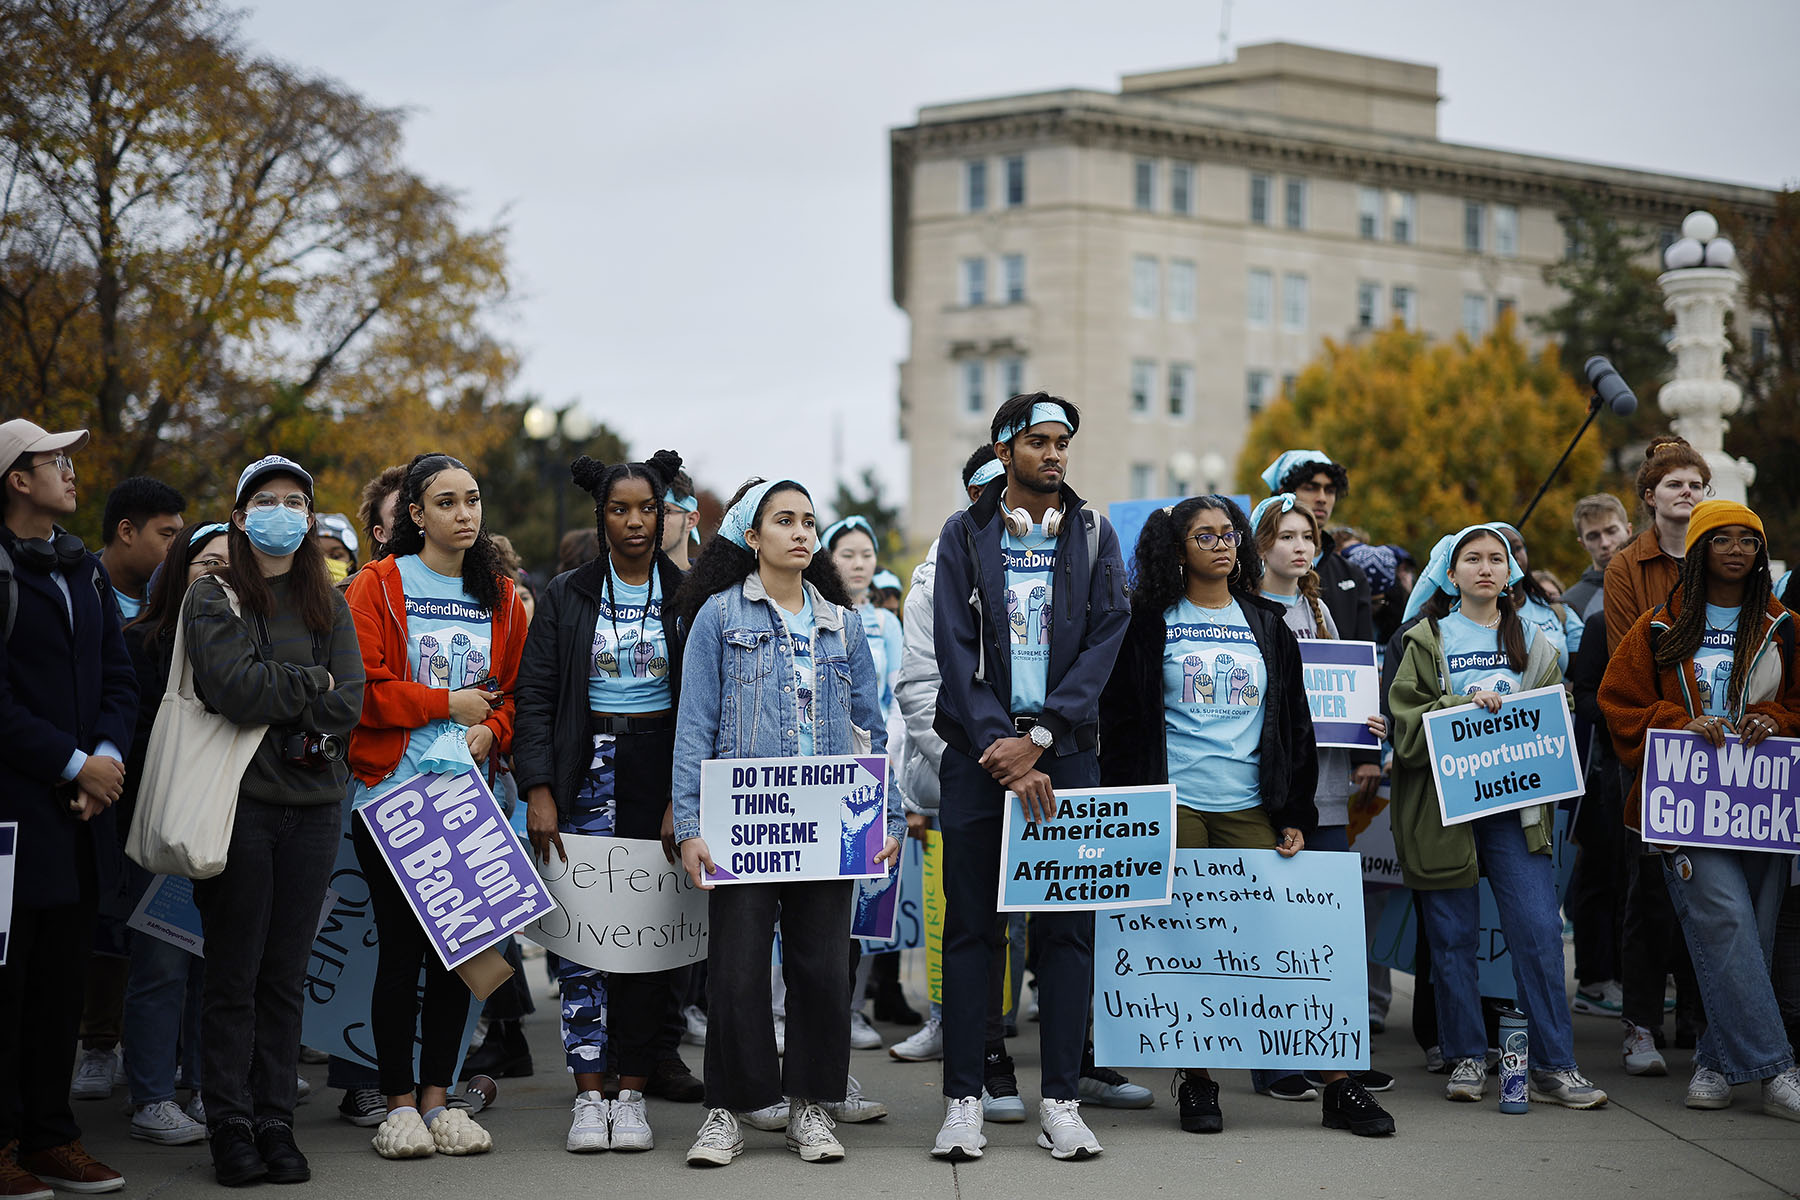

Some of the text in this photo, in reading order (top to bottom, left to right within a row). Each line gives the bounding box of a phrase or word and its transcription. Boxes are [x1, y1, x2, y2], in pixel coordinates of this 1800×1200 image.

[1451, 707, 1541, 742] Diversity
[1440, 733, 1566, 780] Opportunity
[1654, 738, 1709, 785] We
[732, 763, 859, 788] DO THE RIGHT
[1474, 771, 1542, 802] Justice
[731, 792, 796, 817] THING,
[1056, 797, 1129, 819] Asian
[1649, 785, 1695, 836] Go
[731, 821, 818, 846] SUPREME
[1020, 818, 1160, 841] Americans
[425, 772, 539, 929] We Won't
[731, 850, 801, 874] COURT!
[1077, 844, 1105, 860] for
[375, 789, 496, 954] Go Back!
[1013, 857, 1162, 881] Affirmative
[1193, 857, 1258, 883] Land,
[1044, 880, 1130, 901] Action
[1285, 887, 1342, 910] Labor,
[146, 920, 197, 946] #AffirmOpportunity
[1109, 913, 1239, 934] Tokenism,
[1115, 944, 1335, 976] & now this Shit?
[1103, 989, 1193, 1028] Unity,
[1258, 1029, 1362, 1061] DIVERSITY
